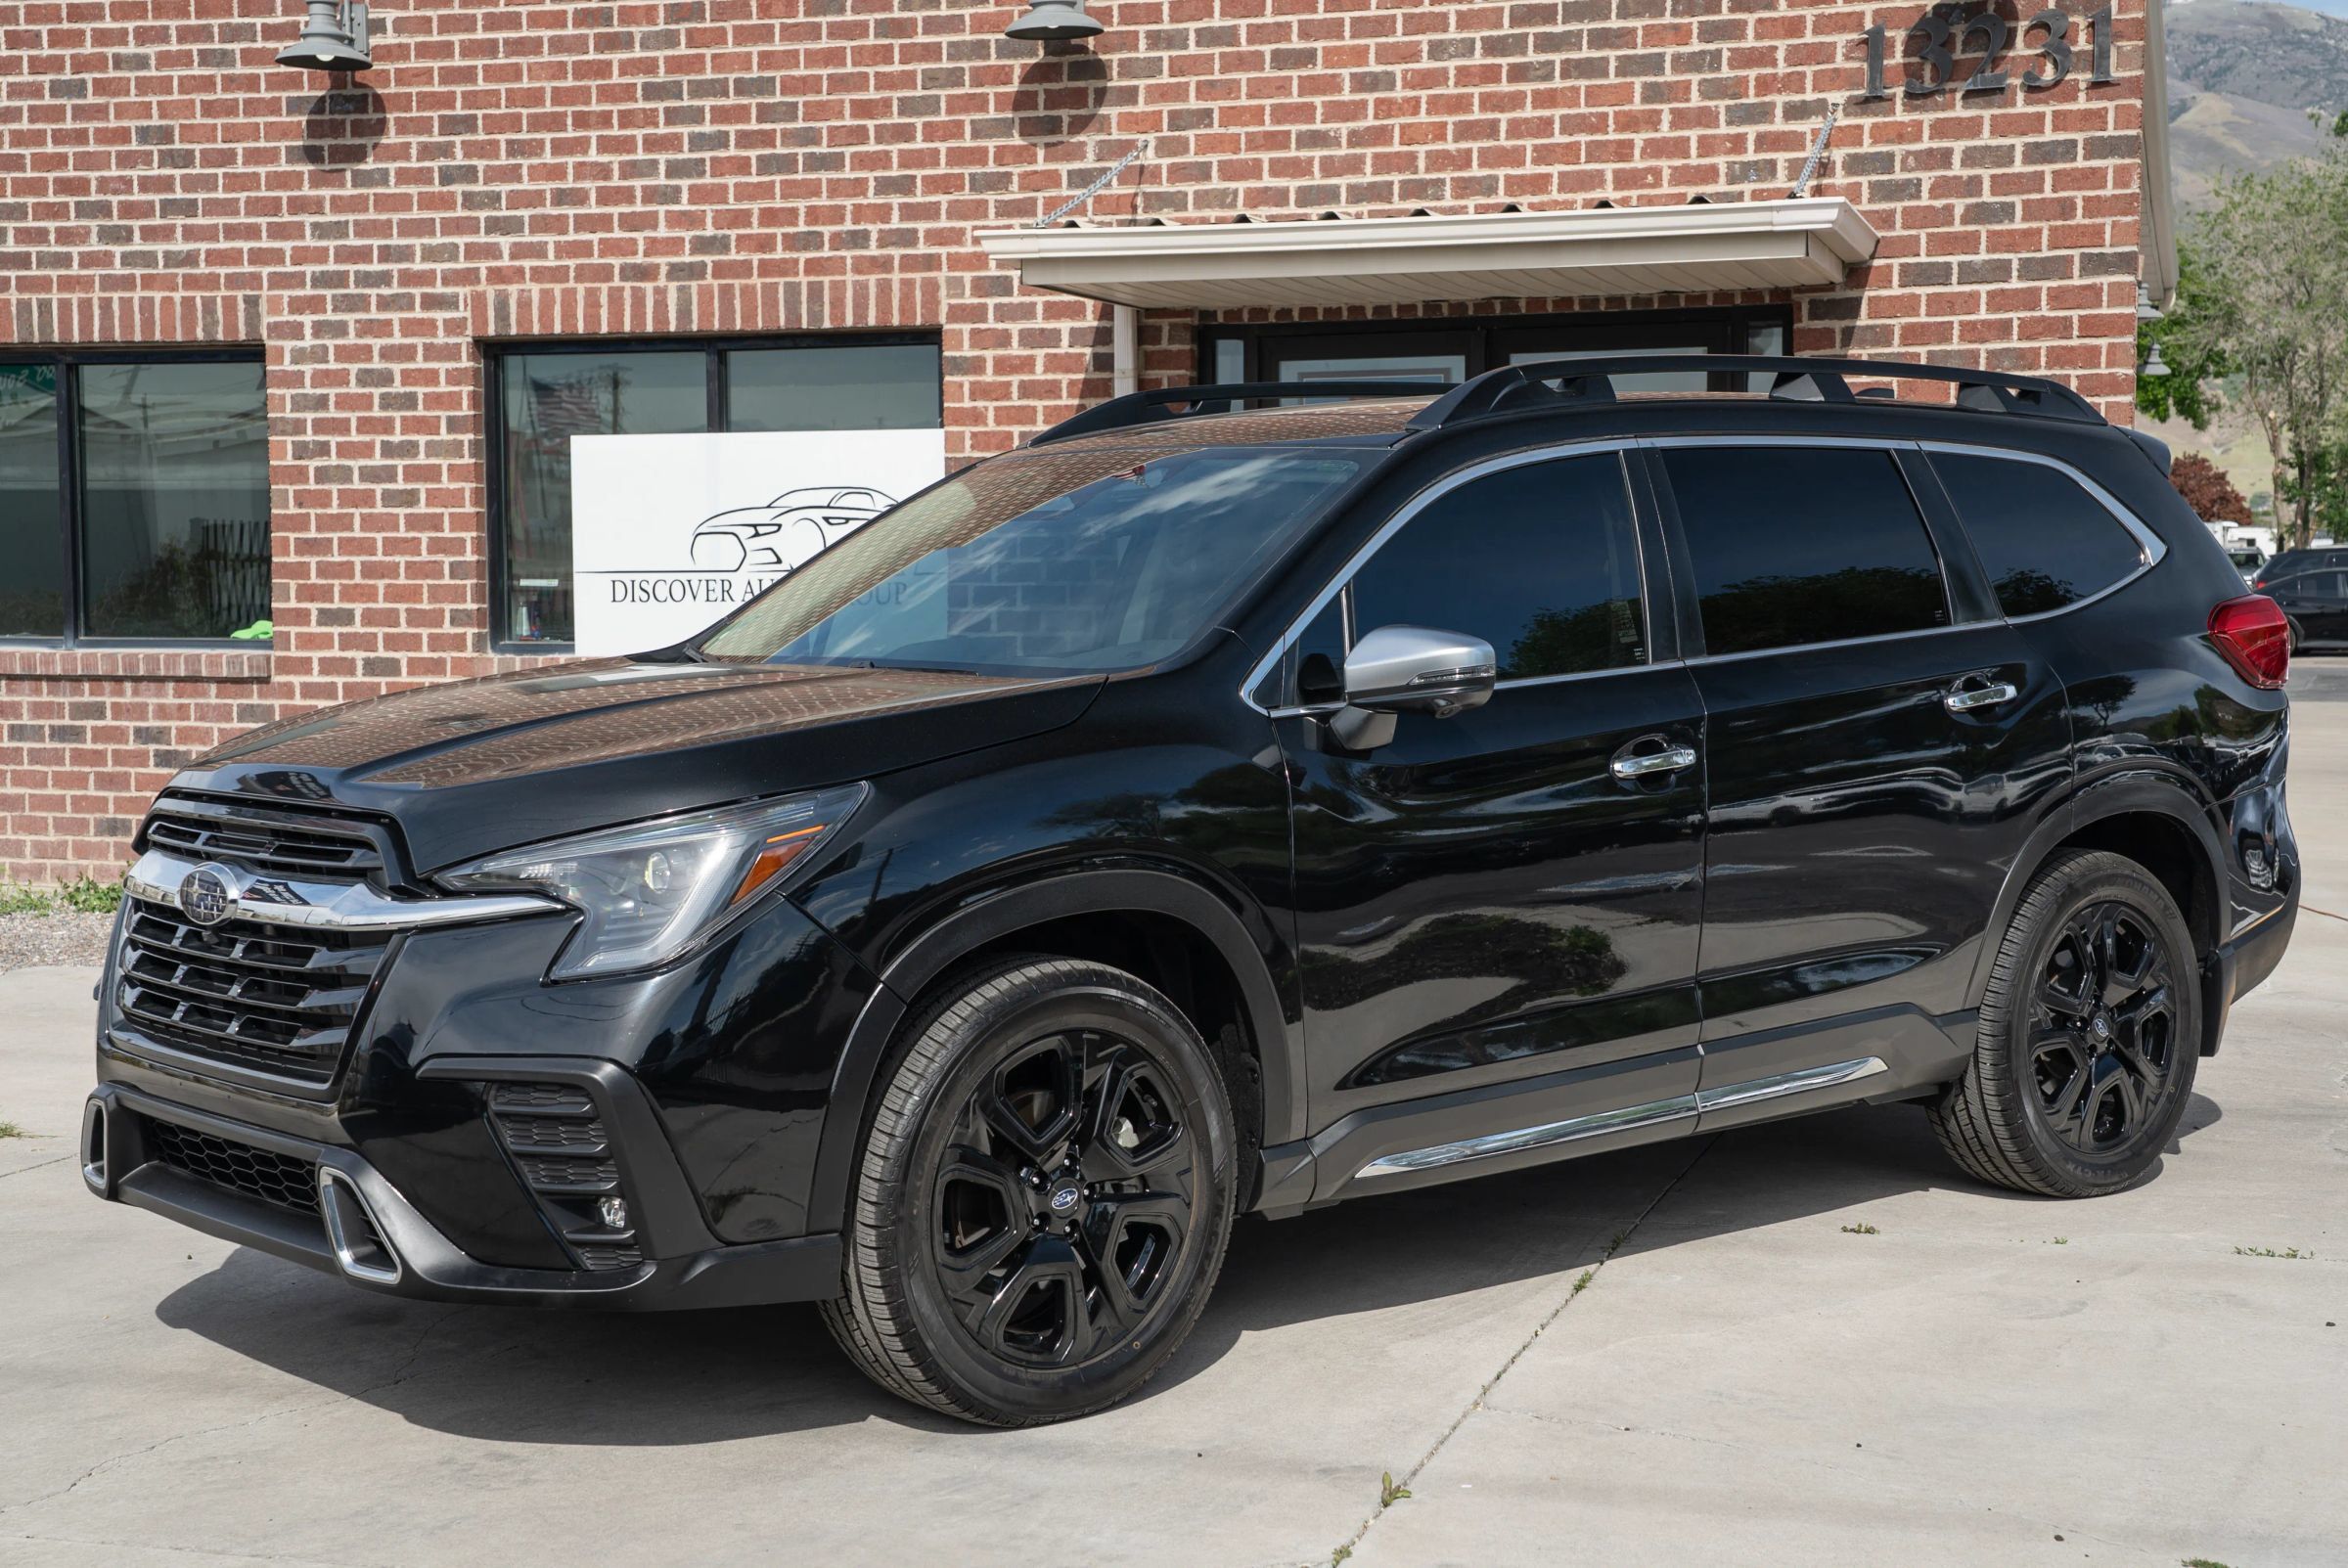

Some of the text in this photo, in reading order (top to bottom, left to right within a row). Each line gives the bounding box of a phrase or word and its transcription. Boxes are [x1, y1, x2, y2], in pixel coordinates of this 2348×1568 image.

[1857, 6, 2115, 97] 13231
[610, 578, 734, 604] DISCOVER
[742, 578, 775, 603] AU
